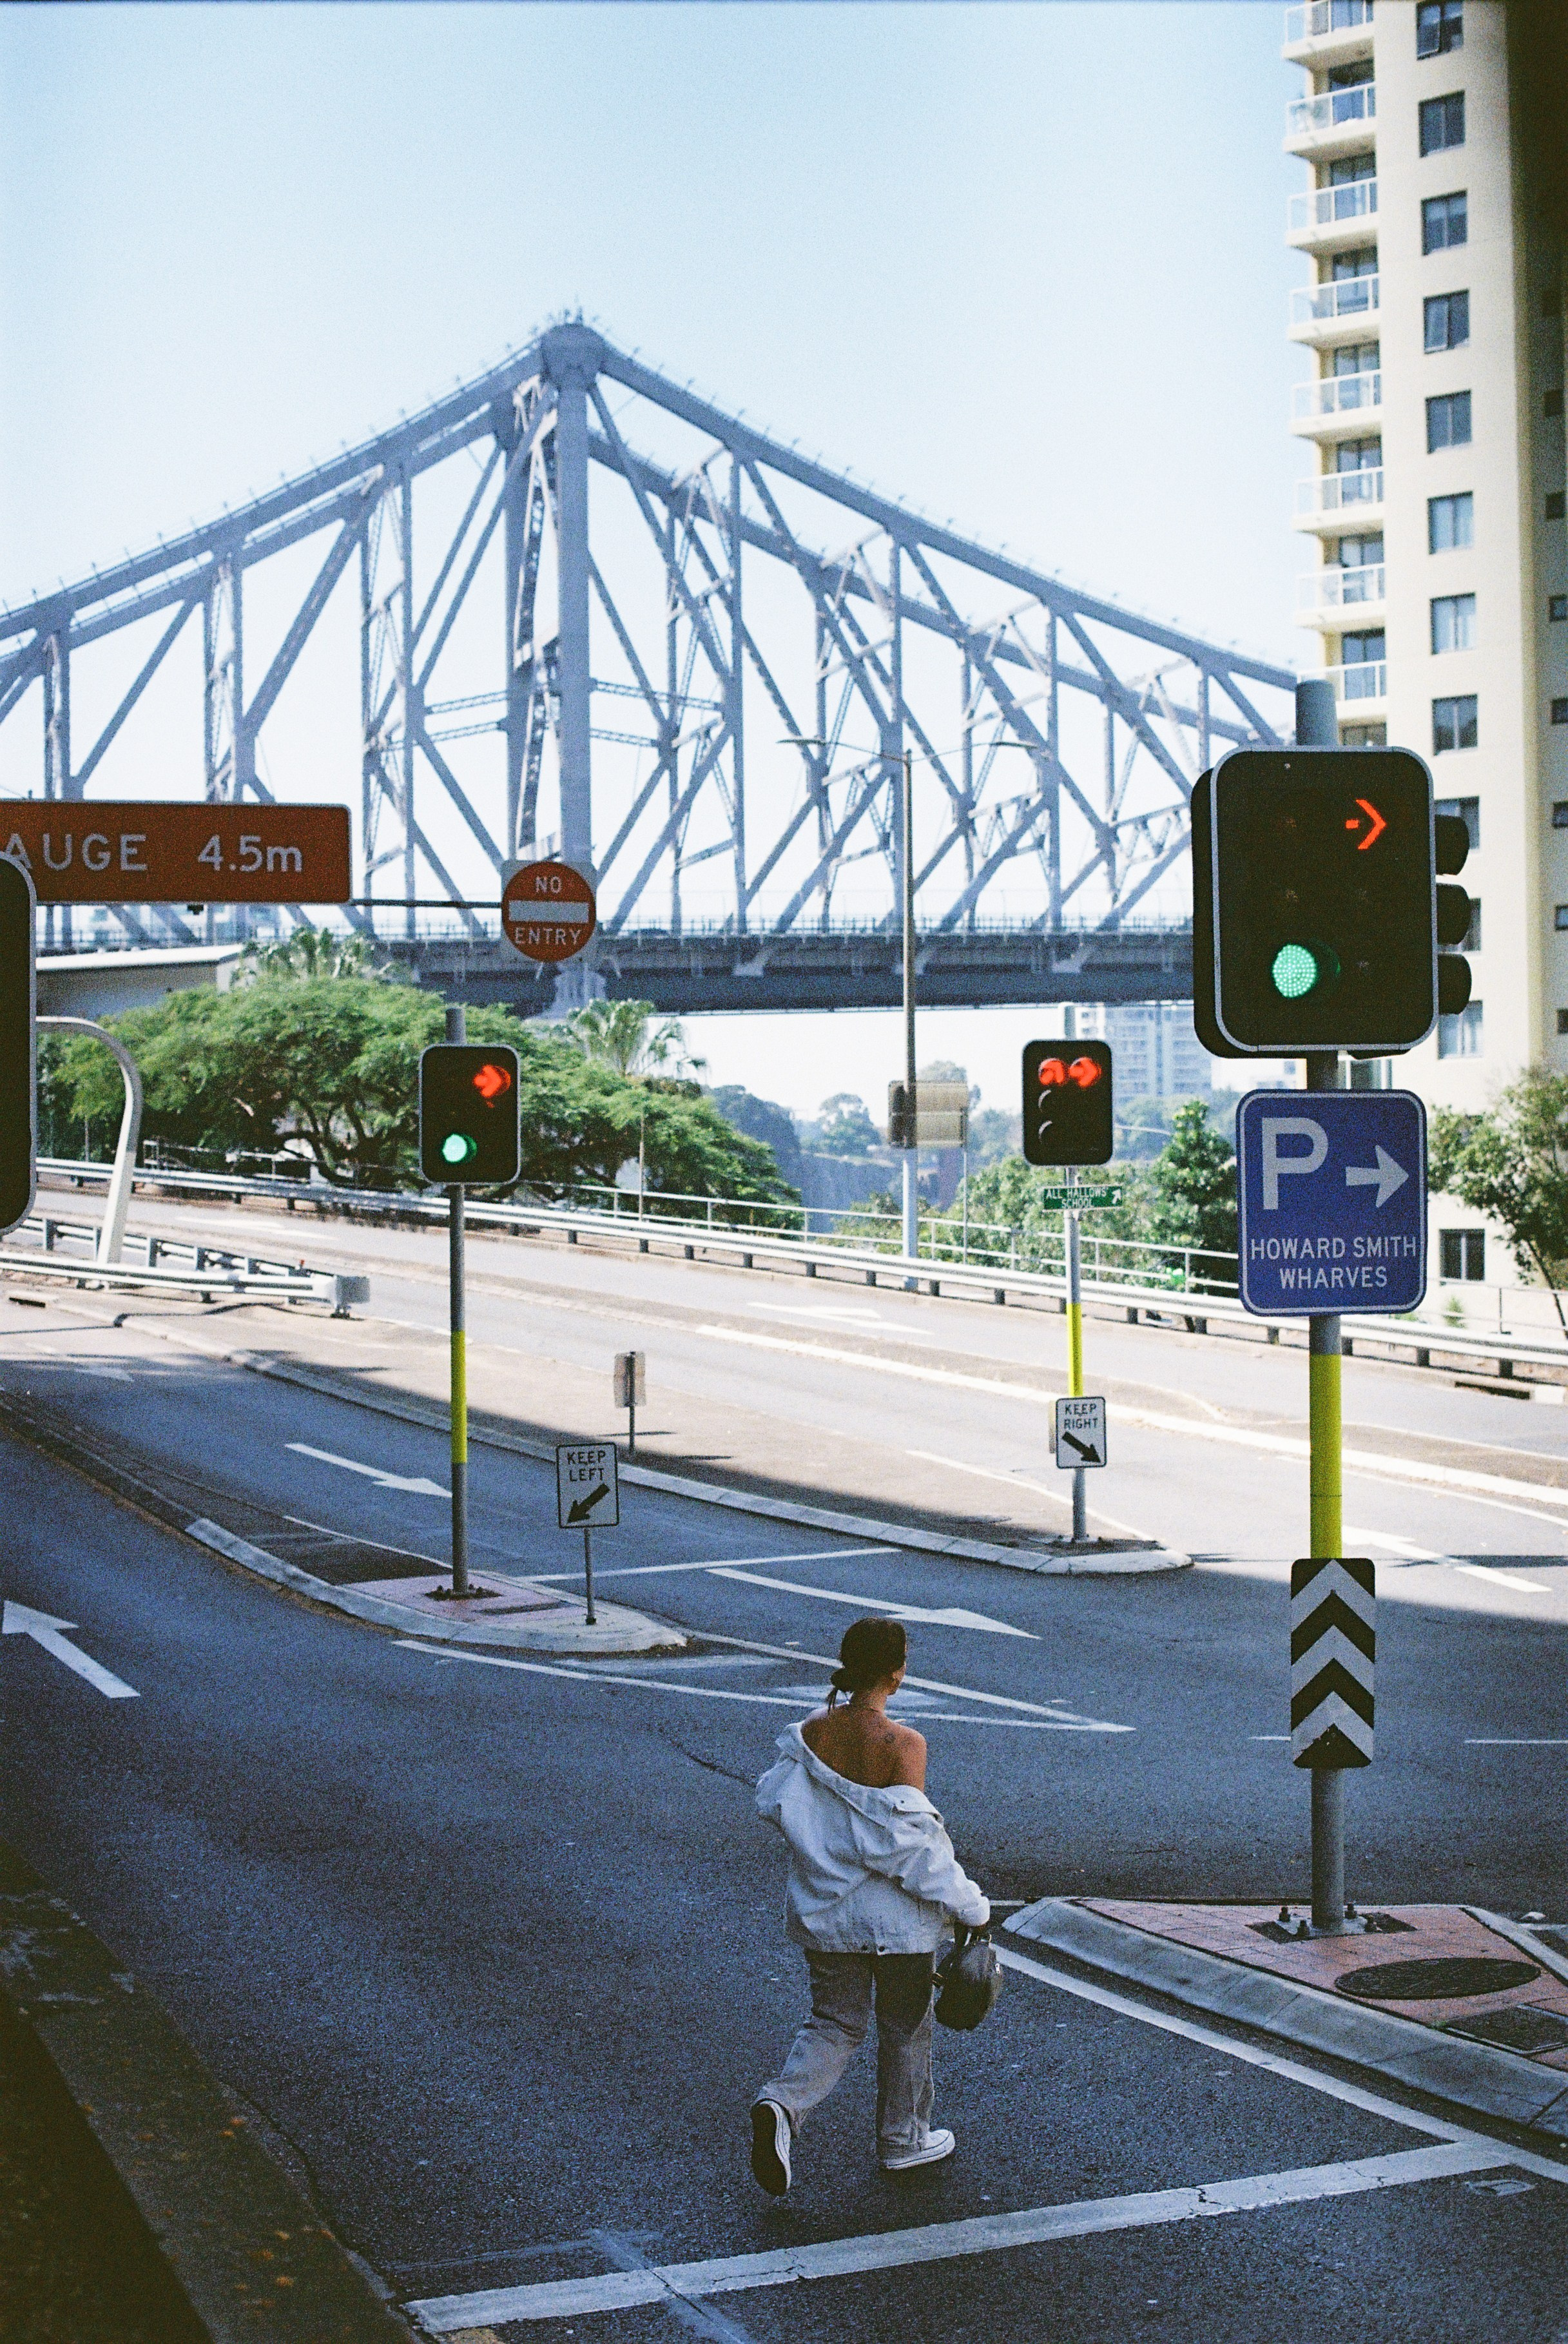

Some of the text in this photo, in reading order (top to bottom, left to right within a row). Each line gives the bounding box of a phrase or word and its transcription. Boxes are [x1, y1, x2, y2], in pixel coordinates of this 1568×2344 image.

[5, 833, 303, 873] AUGE 4.5m
[535, 875, 562, 894] NO
[515, 927, 581, 945] ENTRY
[1262, 1117, 1329, 1210] P
[1046, 1188, 1063, 1199] ALL
[1061, 1197, 1094, 1209] SCHOOL
[1251, 1236, 1417, 1260] HOWARD SMITH
[1279, 1266, 1388, 1289] WHARVES
[1065, 1404, 1097, 1415] KEEP
[1064, 1418, 1098, 1429] RIGHT
[567, 1450, 606, 1465] KEEP
[569, 1467, 604, 1482] LEFT
